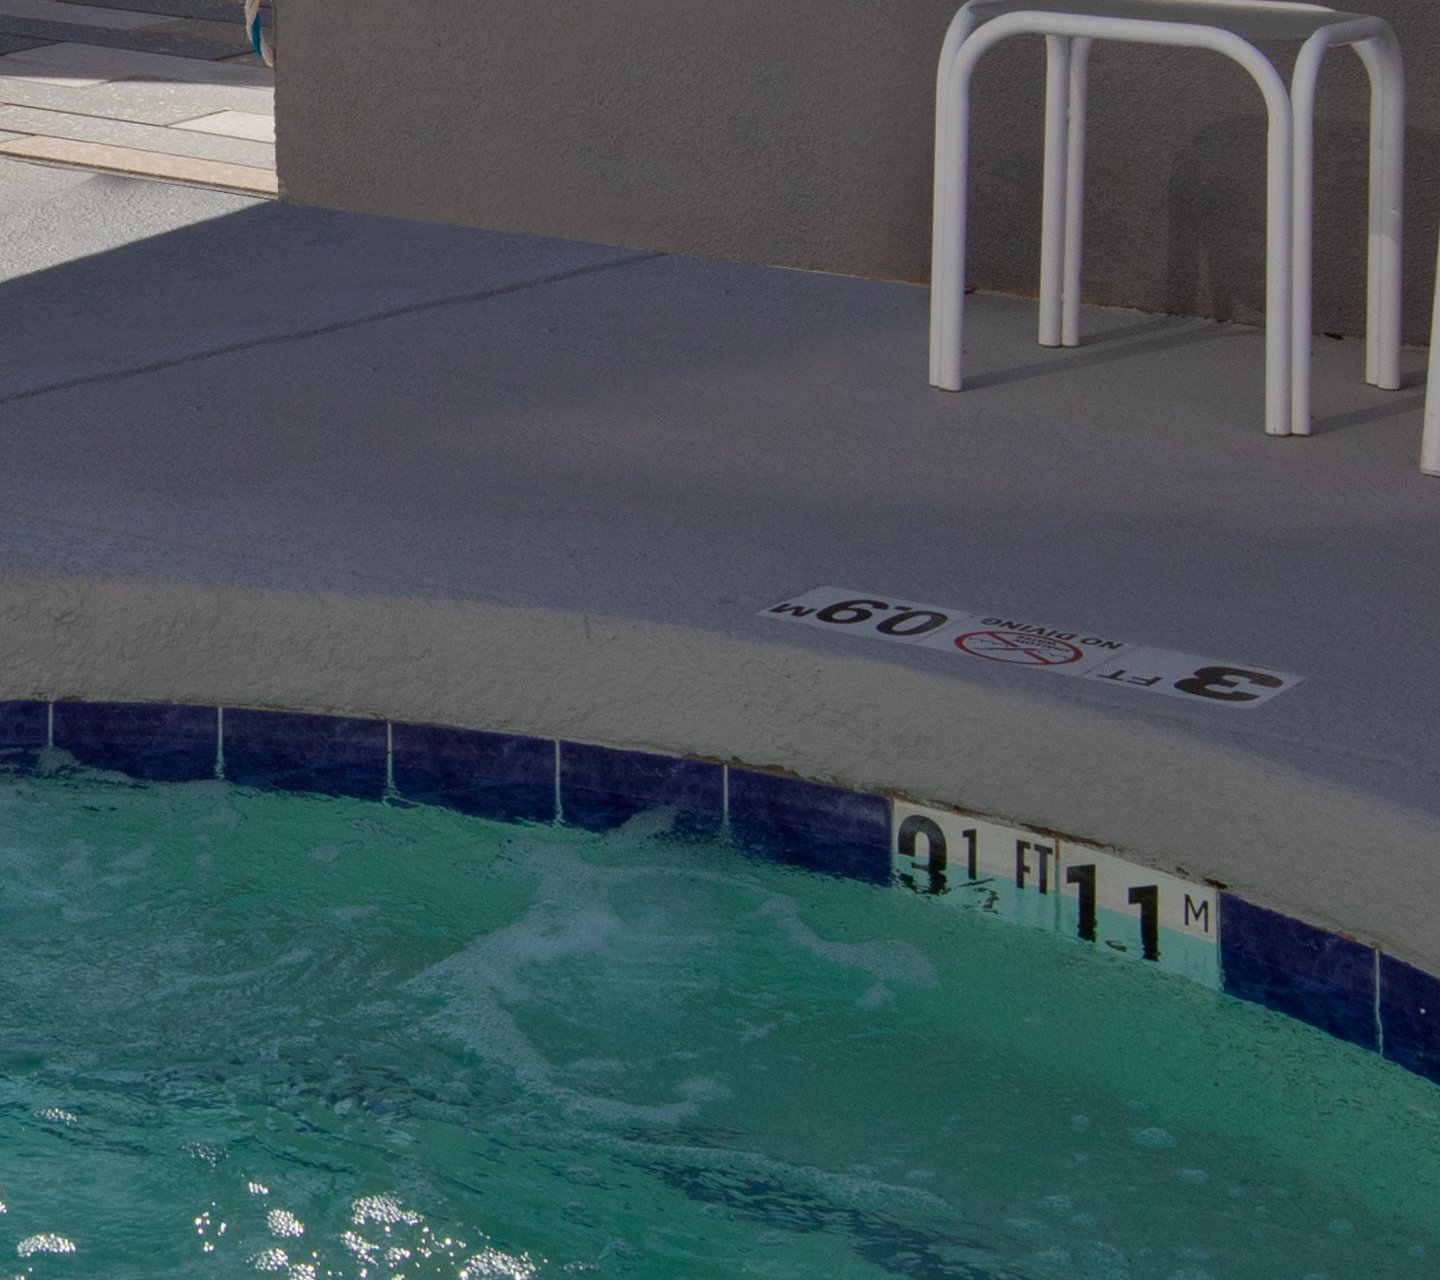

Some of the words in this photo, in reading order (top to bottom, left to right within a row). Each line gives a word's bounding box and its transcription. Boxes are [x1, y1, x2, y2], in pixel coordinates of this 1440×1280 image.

[769, 603, 817, 617] M
[816, 599, 948, 636] 0.9
[980, 618, 1077, 641] DIVING
[1080, 637, 1123, 650] NO
[1097, 669, 1163, 687] FT
[1173, 666, 1283, 702] 3
[1016, 838, 1053, 895] FT
[1184, 893, 1209, 934] M
